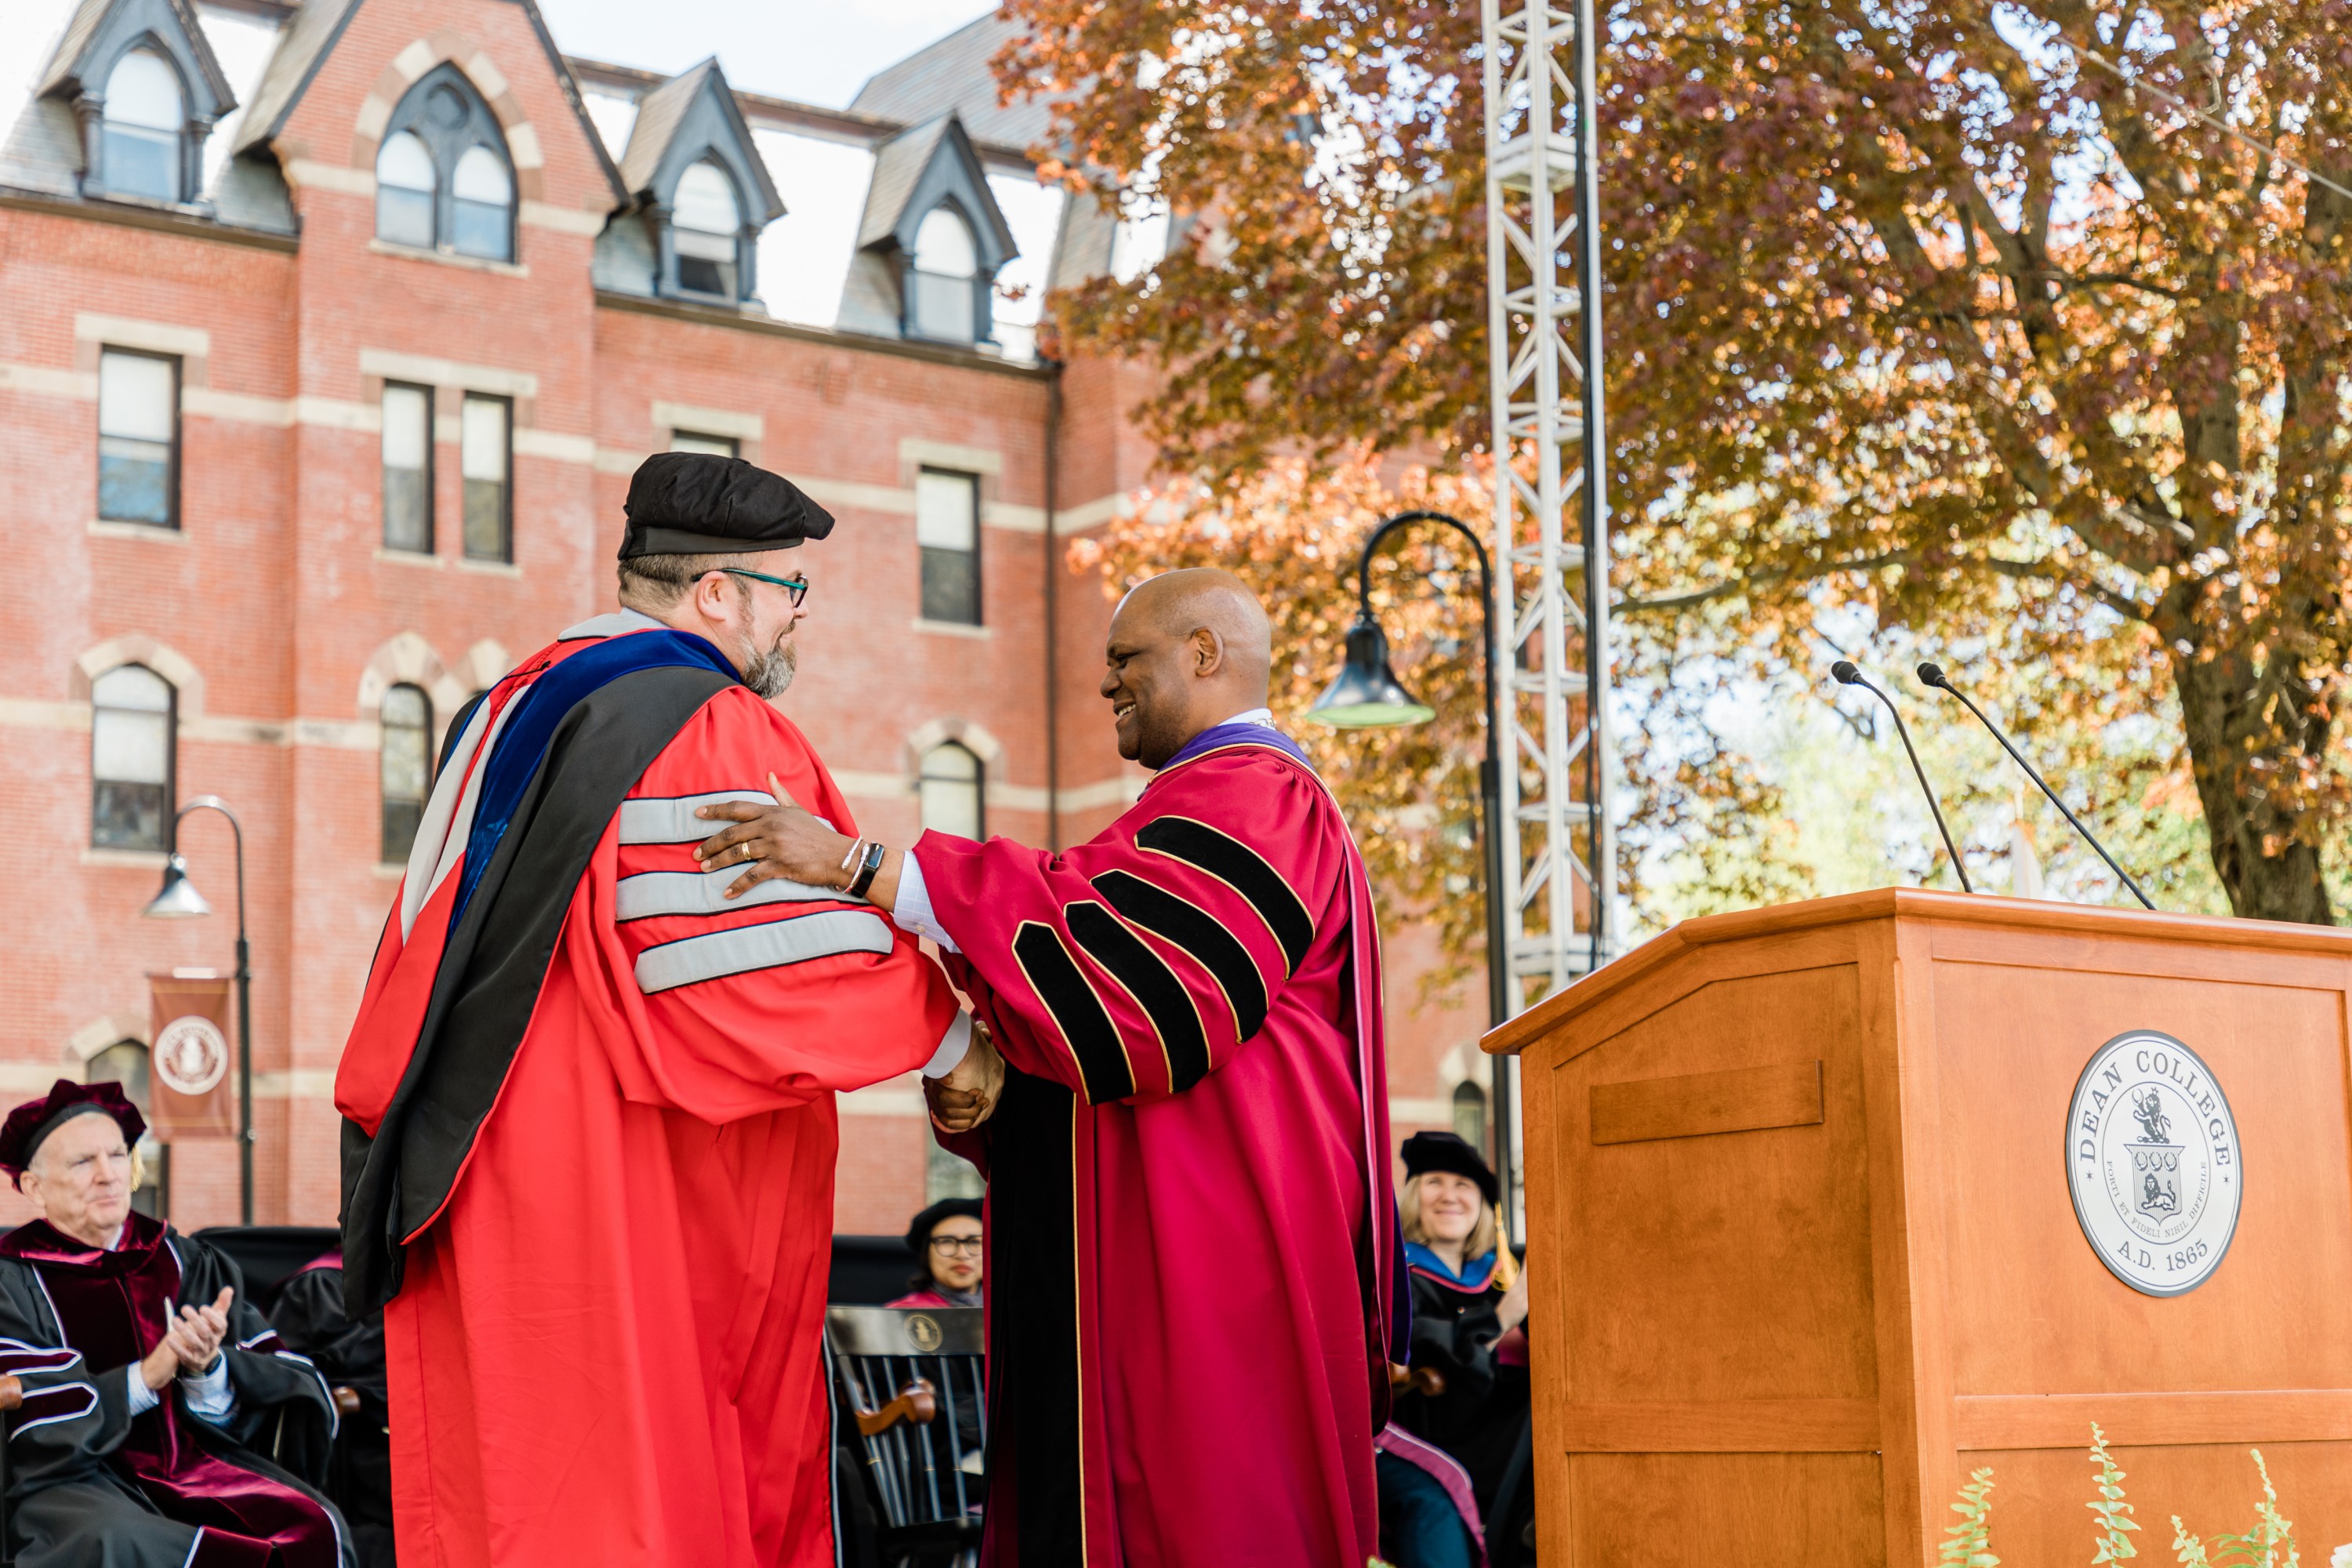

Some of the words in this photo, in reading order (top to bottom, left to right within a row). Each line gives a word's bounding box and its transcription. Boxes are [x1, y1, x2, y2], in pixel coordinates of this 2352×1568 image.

[2080, 1062, 2123, 1163] DEAN
[2136, 1050, 2230, 1166] COLLEGE
[2107, 1160, 2120, 1198] FORTI
[2118, 1201, 2130, 1217] ET
[2131, 1218, 2161, 1238] FIDELI
[2165, 1221, 2189, 1238] NIHIL
[2189, 1161, 2207, 1220] DIFFICILE
[2118, 1240, 2155, 1271] A.D.
[2166, 1238, 2208, 1272] 1865
